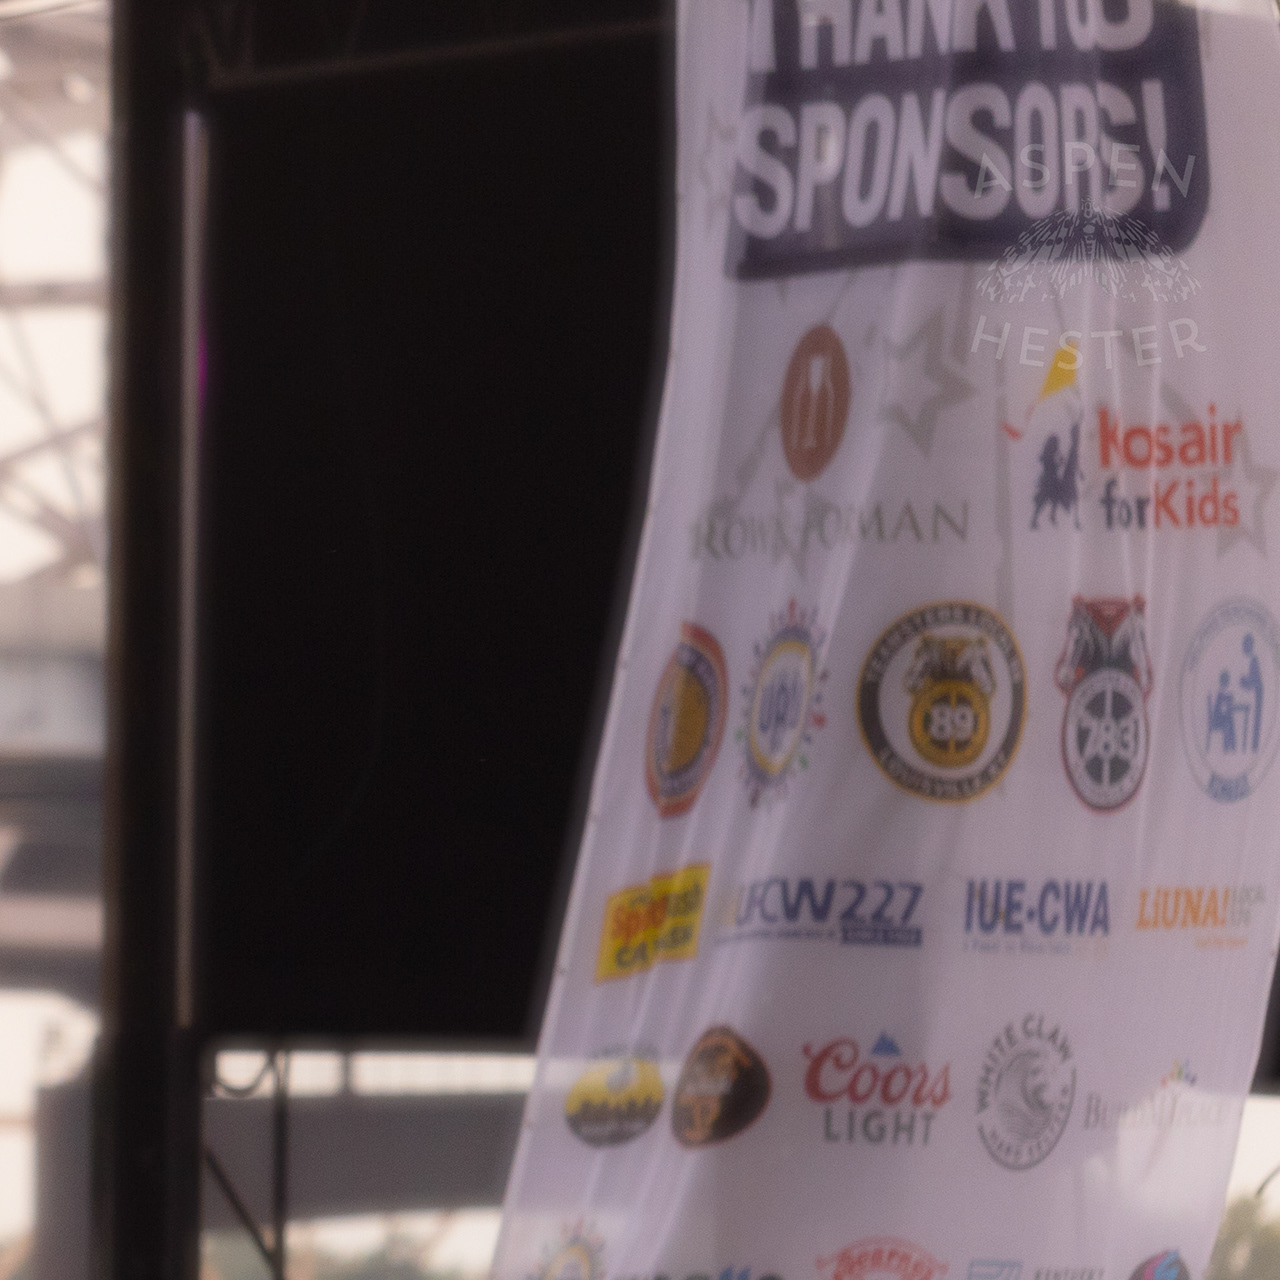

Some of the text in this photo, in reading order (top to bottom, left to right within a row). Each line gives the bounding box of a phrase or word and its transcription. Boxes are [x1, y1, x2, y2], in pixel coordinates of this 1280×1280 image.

[930, 704, 975, 742] 89
[1075, 716, 1138, 759] 783
[1000, 1011, 1073, 1063] CLAW
[801, 1036, 952, 1109] Coors
[824, 1108, 936, 1145] LIGHT
